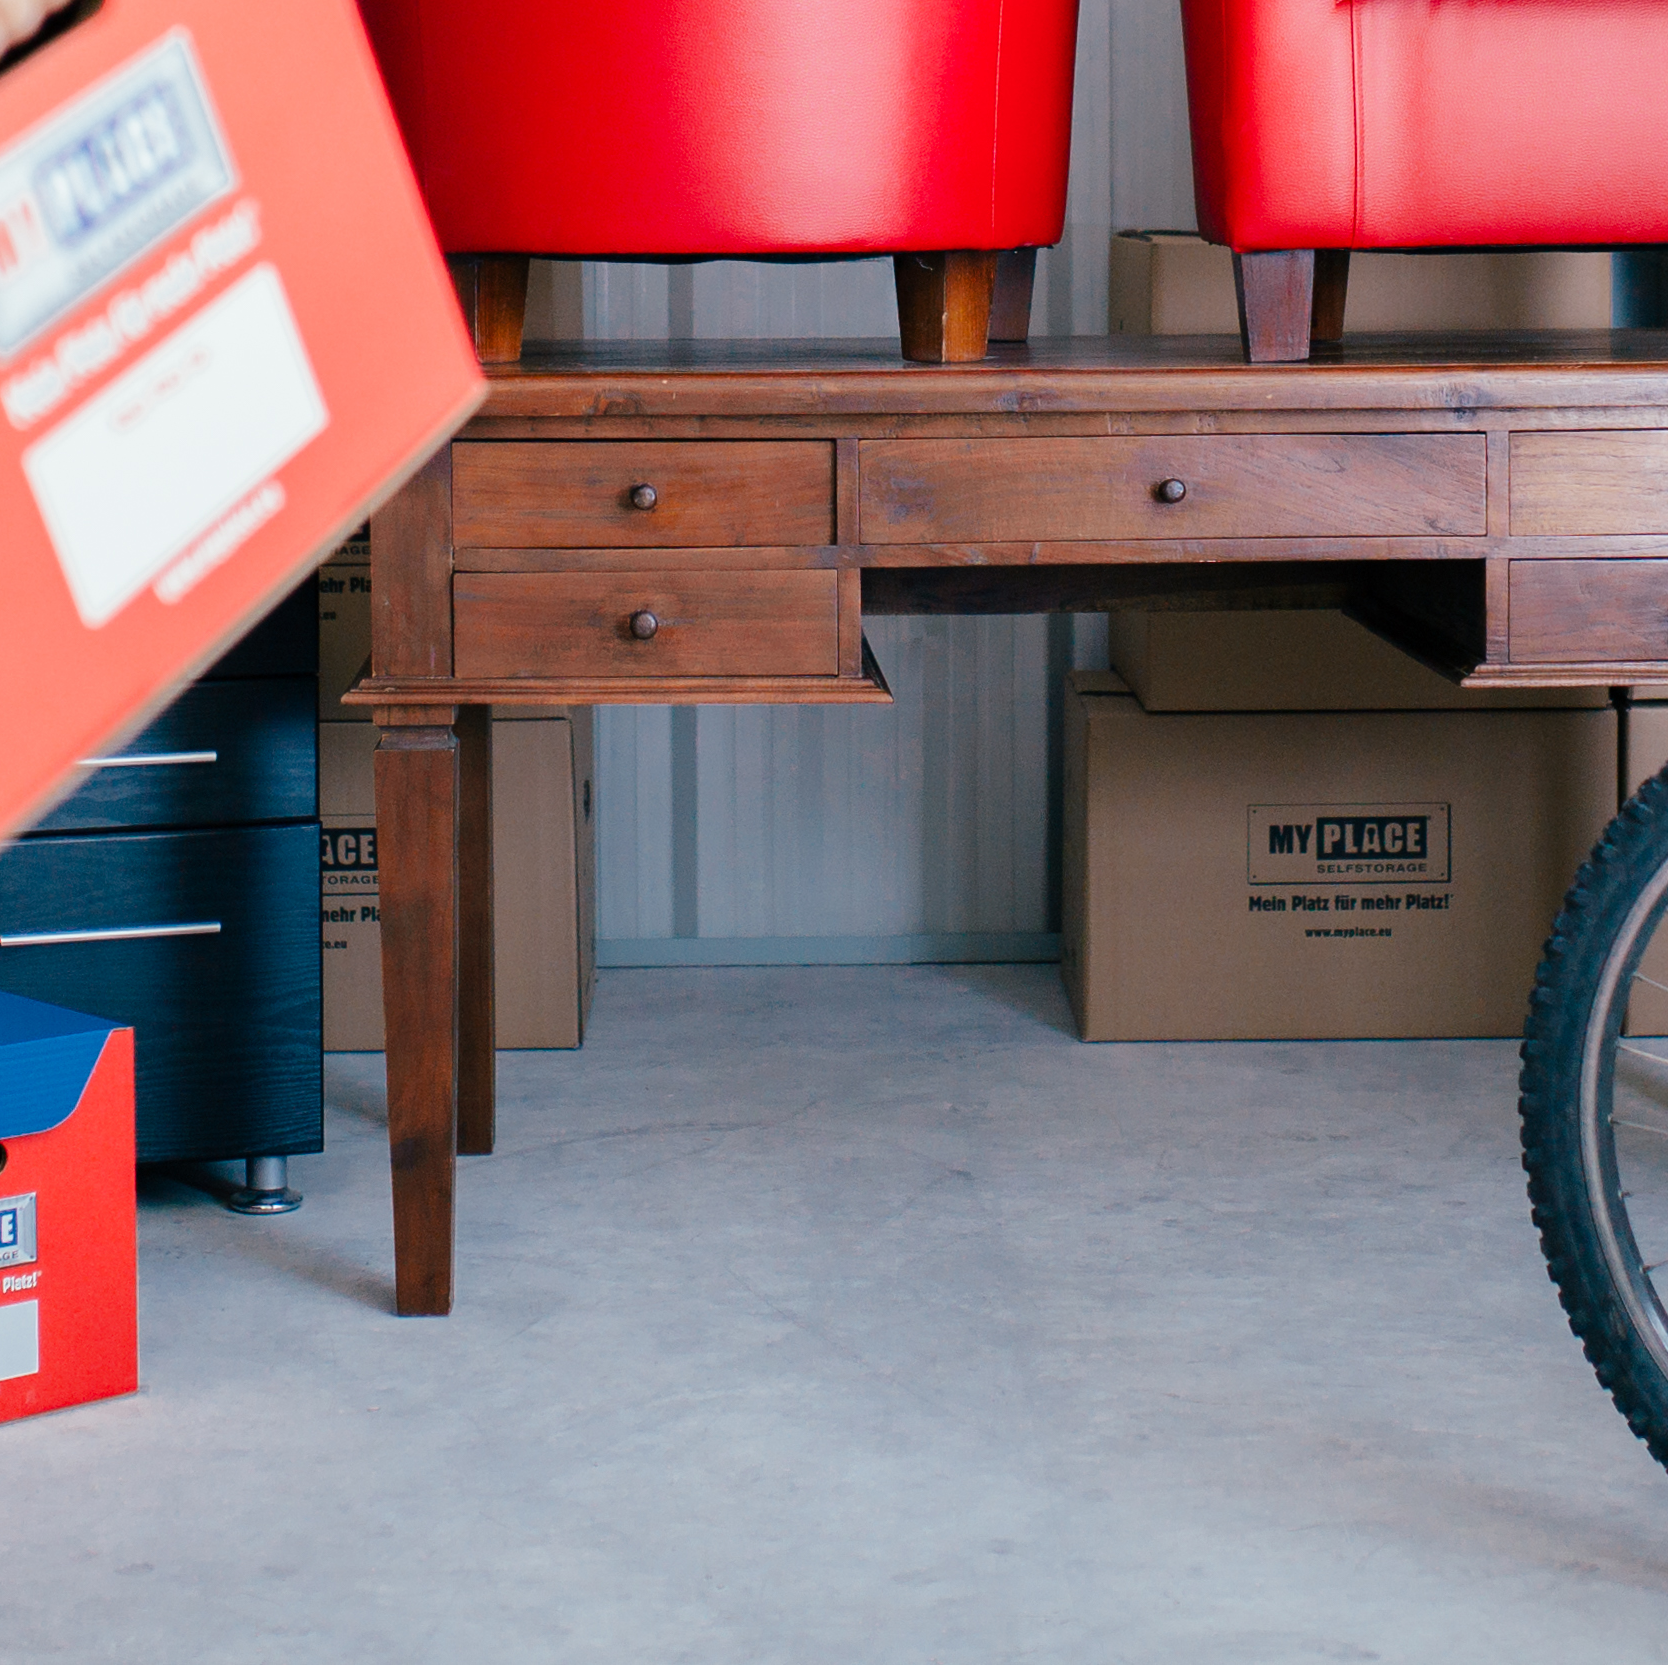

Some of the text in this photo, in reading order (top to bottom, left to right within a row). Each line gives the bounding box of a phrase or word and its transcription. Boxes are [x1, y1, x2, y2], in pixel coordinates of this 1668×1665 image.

[1269, 822, 1422, 854] MY PLACE
[1317, 863, 1427, 874] SELFSTORAGE
[1248, 893, 1450, 912] Mein Platz für mehr Platz!
[2, 1271, 38, 1294] Platz!
